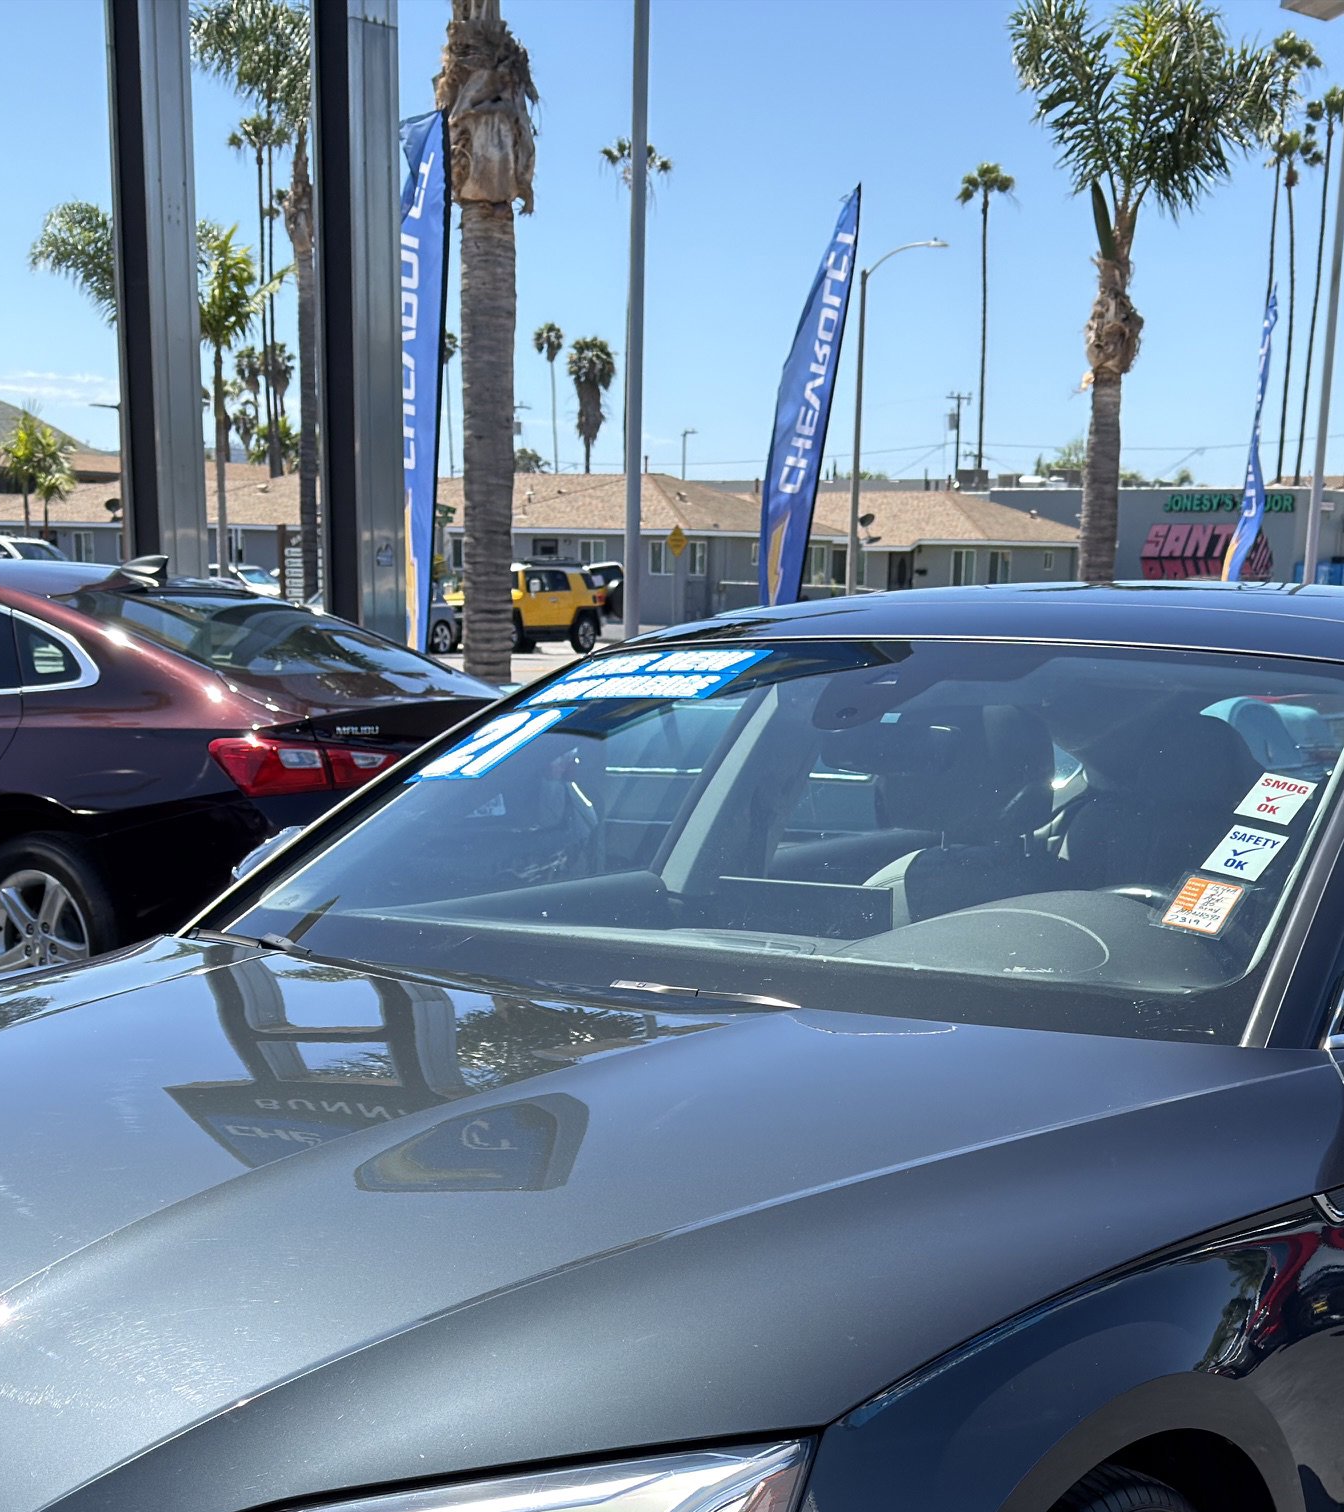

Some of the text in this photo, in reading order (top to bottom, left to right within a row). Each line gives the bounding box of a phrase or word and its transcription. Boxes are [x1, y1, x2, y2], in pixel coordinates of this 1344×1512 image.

[1164, 494, 1232, 512] JONESY'S
[1141, 523, 1238, 558] SANT
[418, 709, 562, 777] 21
[1261, 778, 1309, 795] SMOG
[1256, 803, 1281, 815] OK
[1229, 831, 1281, 849] SAFETY
[1223, 858, 1249, 871] OK
